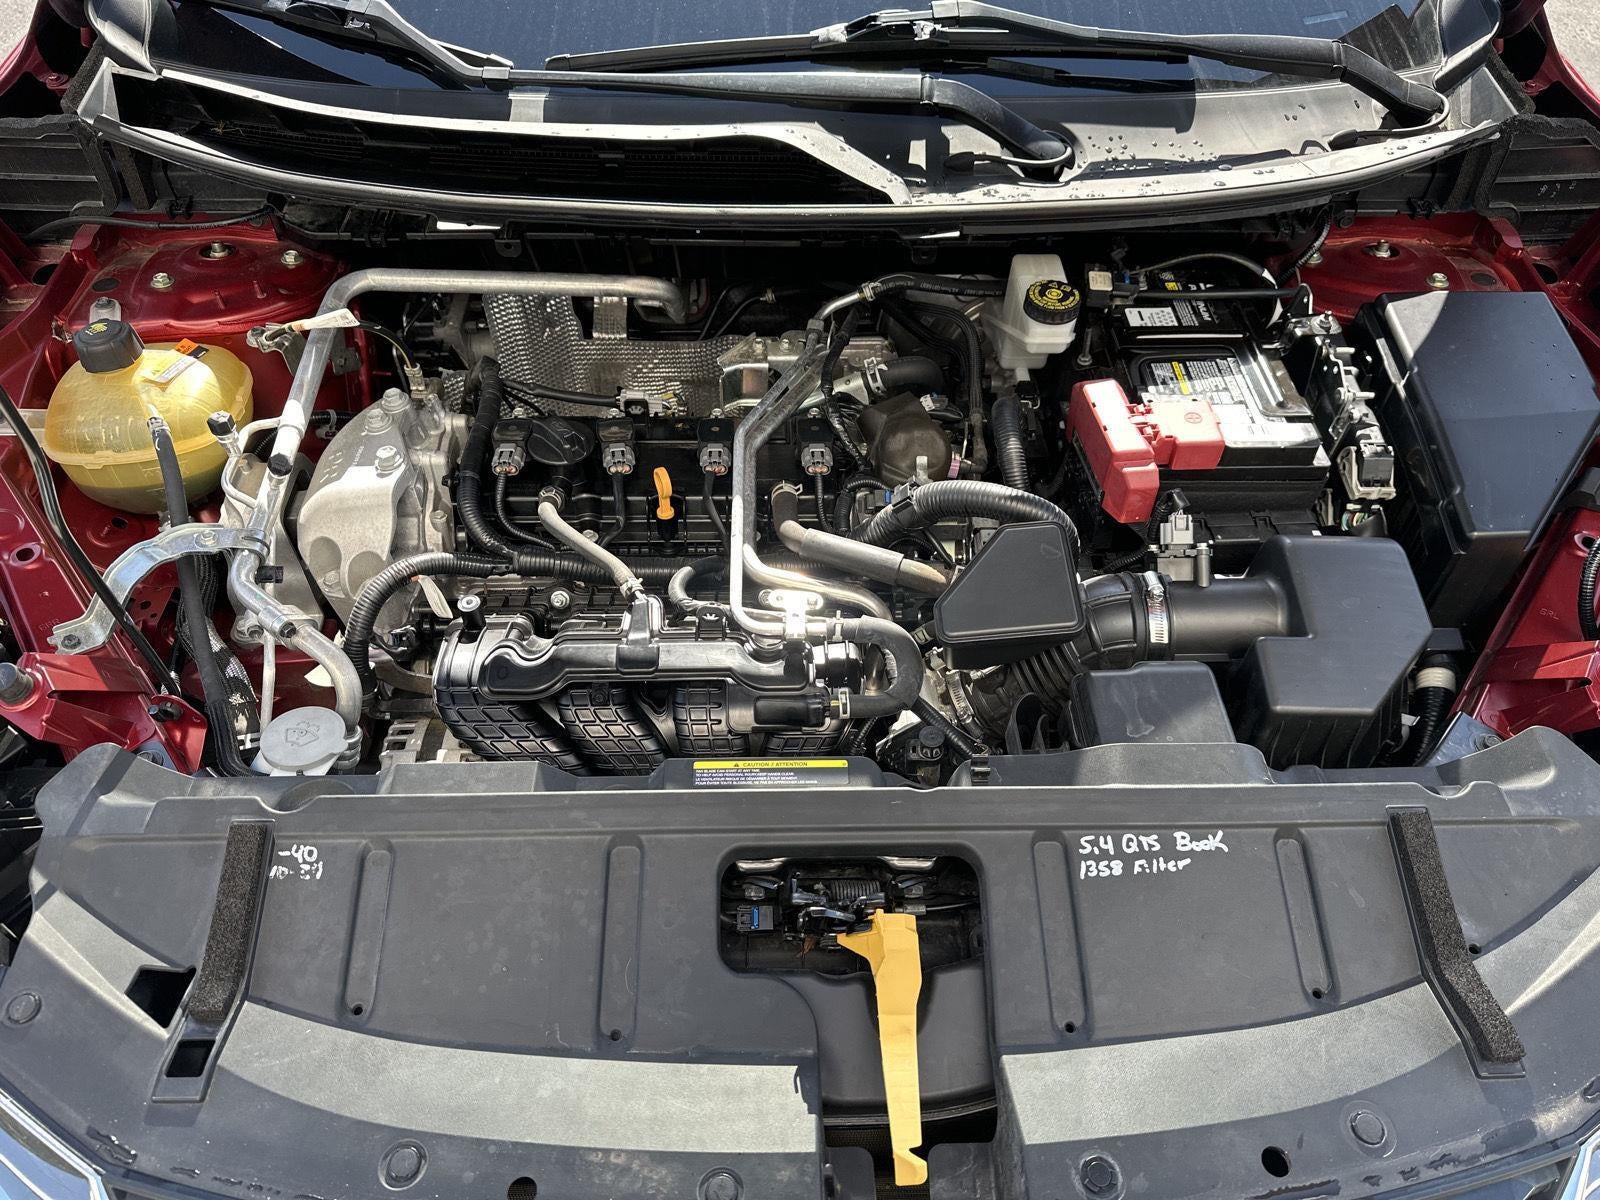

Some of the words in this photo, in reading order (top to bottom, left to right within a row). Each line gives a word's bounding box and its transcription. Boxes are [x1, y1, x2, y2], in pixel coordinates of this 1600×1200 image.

[1078, 834, 1115, 855] 5.4
[1121, 833, 1161, 854] QTS
[1079, 859, 1124, 880] 1358
